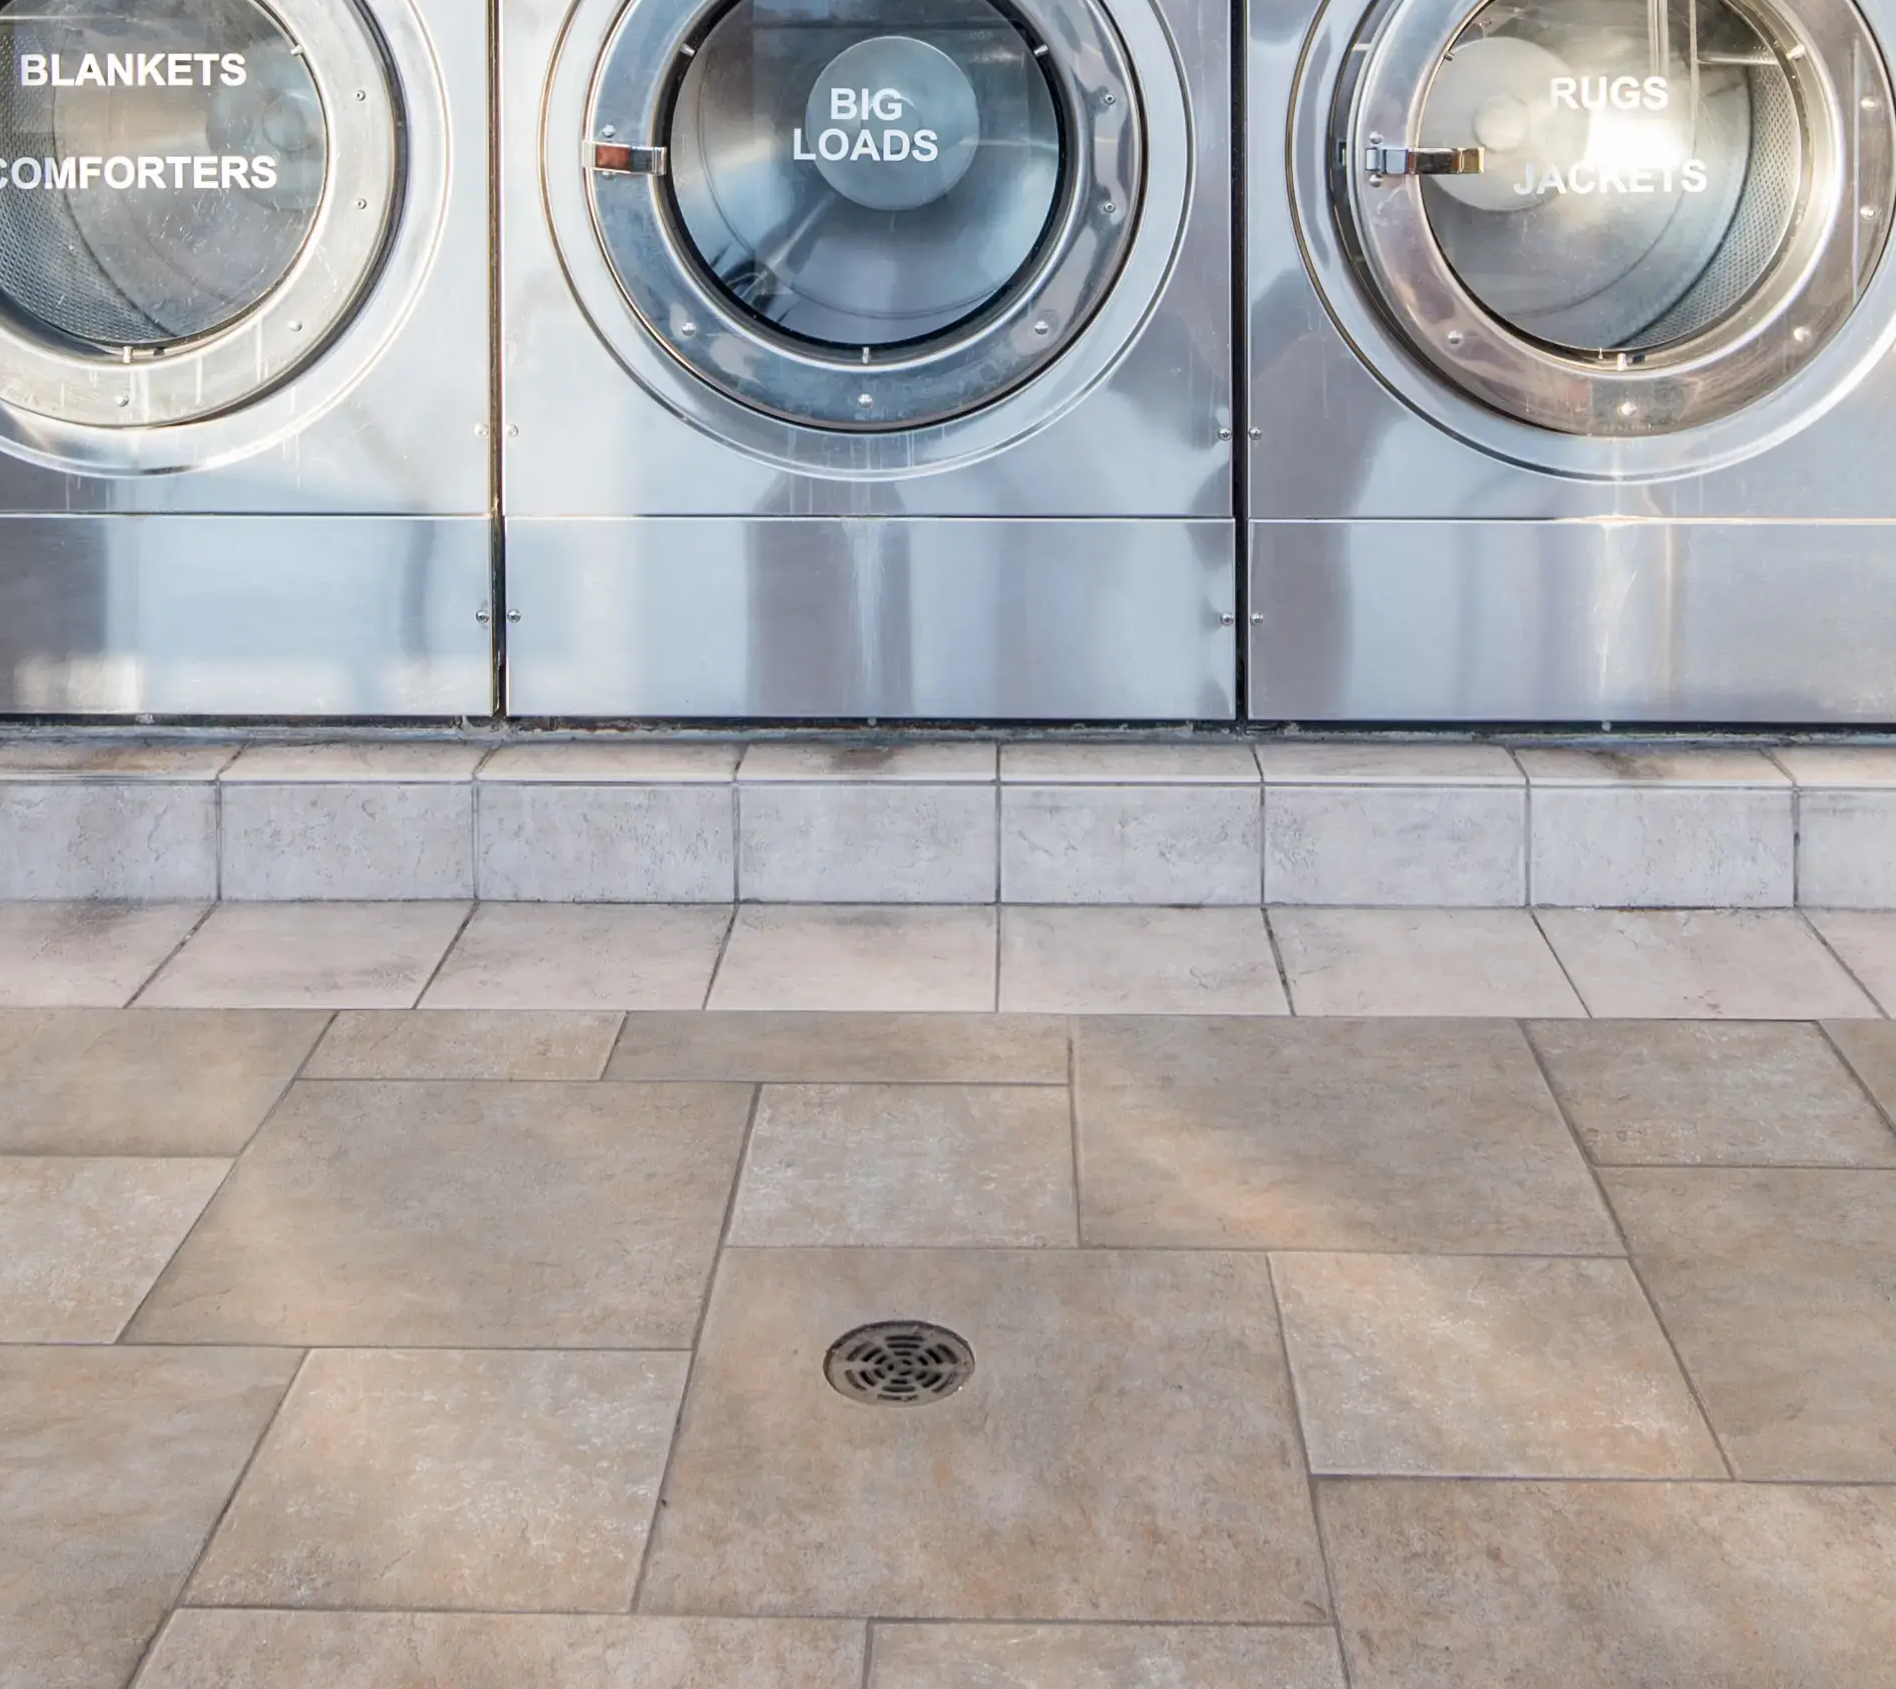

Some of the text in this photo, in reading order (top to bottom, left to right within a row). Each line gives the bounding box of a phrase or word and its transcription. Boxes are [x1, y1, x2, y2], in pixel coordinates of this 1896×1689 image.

[20, 53, 247, 86] BLANKETS
[830, 87, 902, 121] BIG
[1550, 76, 1668, 110] RUGS
[793, 128, 939, 162] LOADS
[1513, 159, 1708, 195] JACKETS
